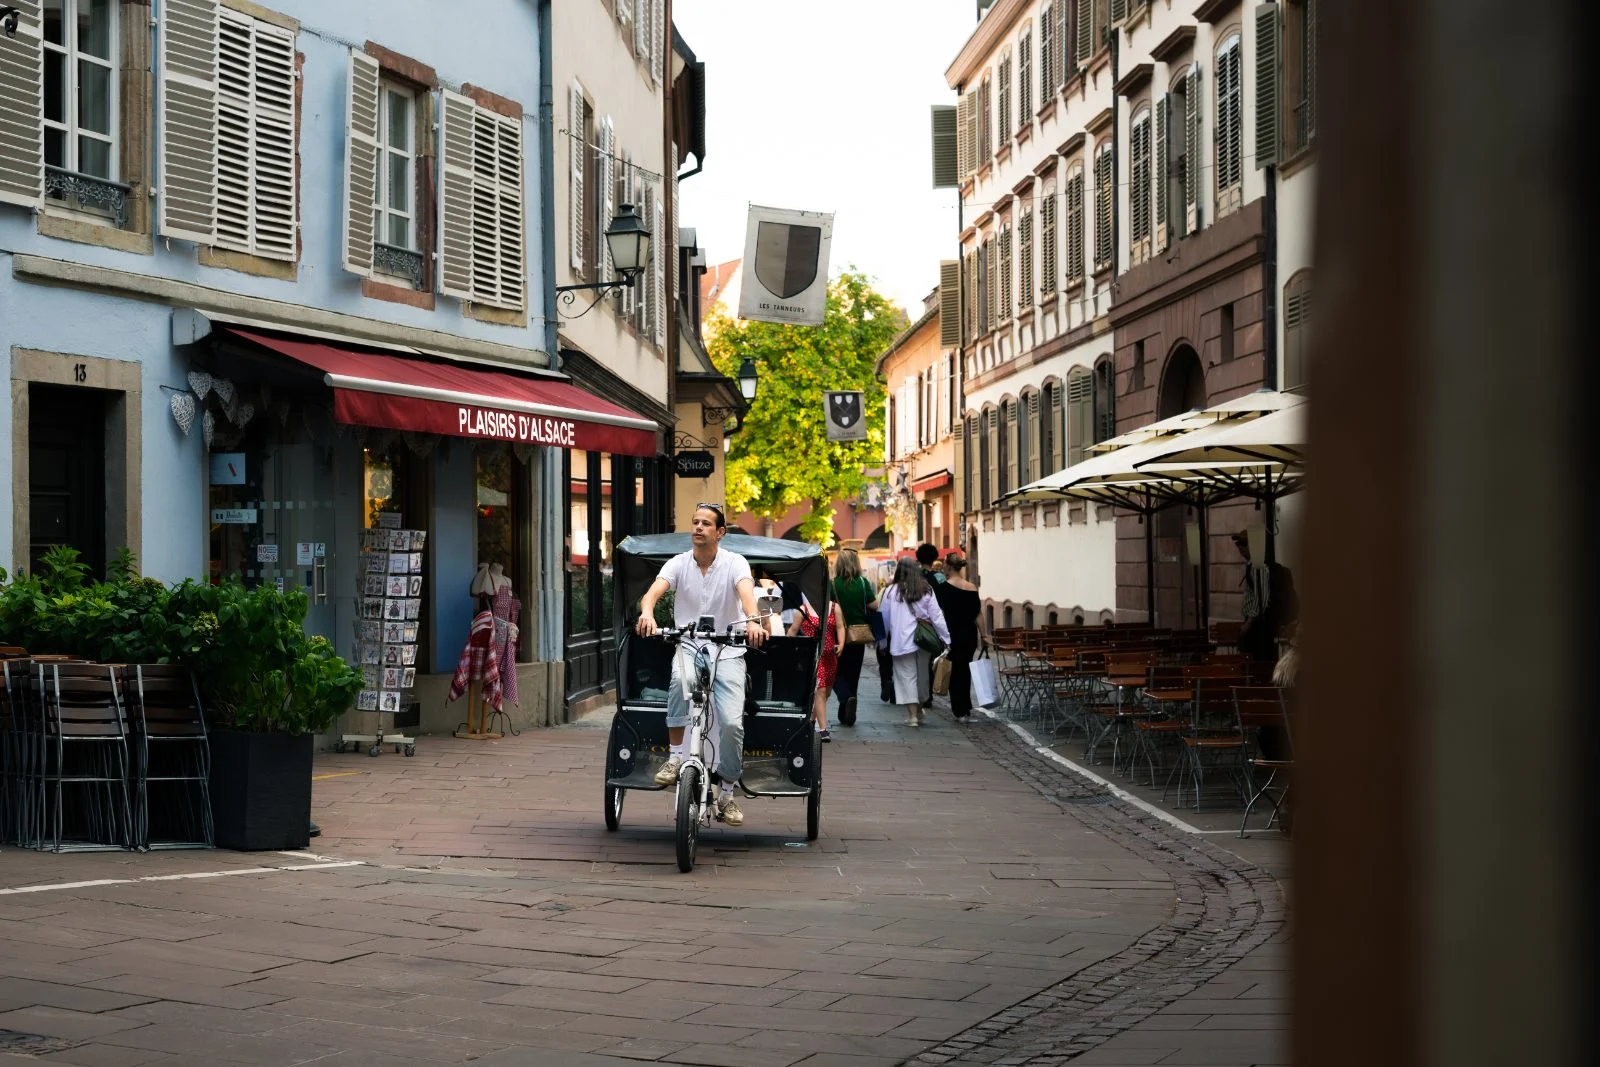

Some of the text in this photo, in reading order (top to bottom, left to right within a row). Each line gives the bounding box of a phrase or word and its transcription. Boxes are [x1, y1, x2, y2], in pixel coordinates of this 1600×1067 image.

[773, 304, 805, 313] TANNEURS
[74, 363, 87, 382] 13
[458, 408, 575, 445] PLAISIRS D'ALSACE
[677, 459, 711, 472] Spitze
